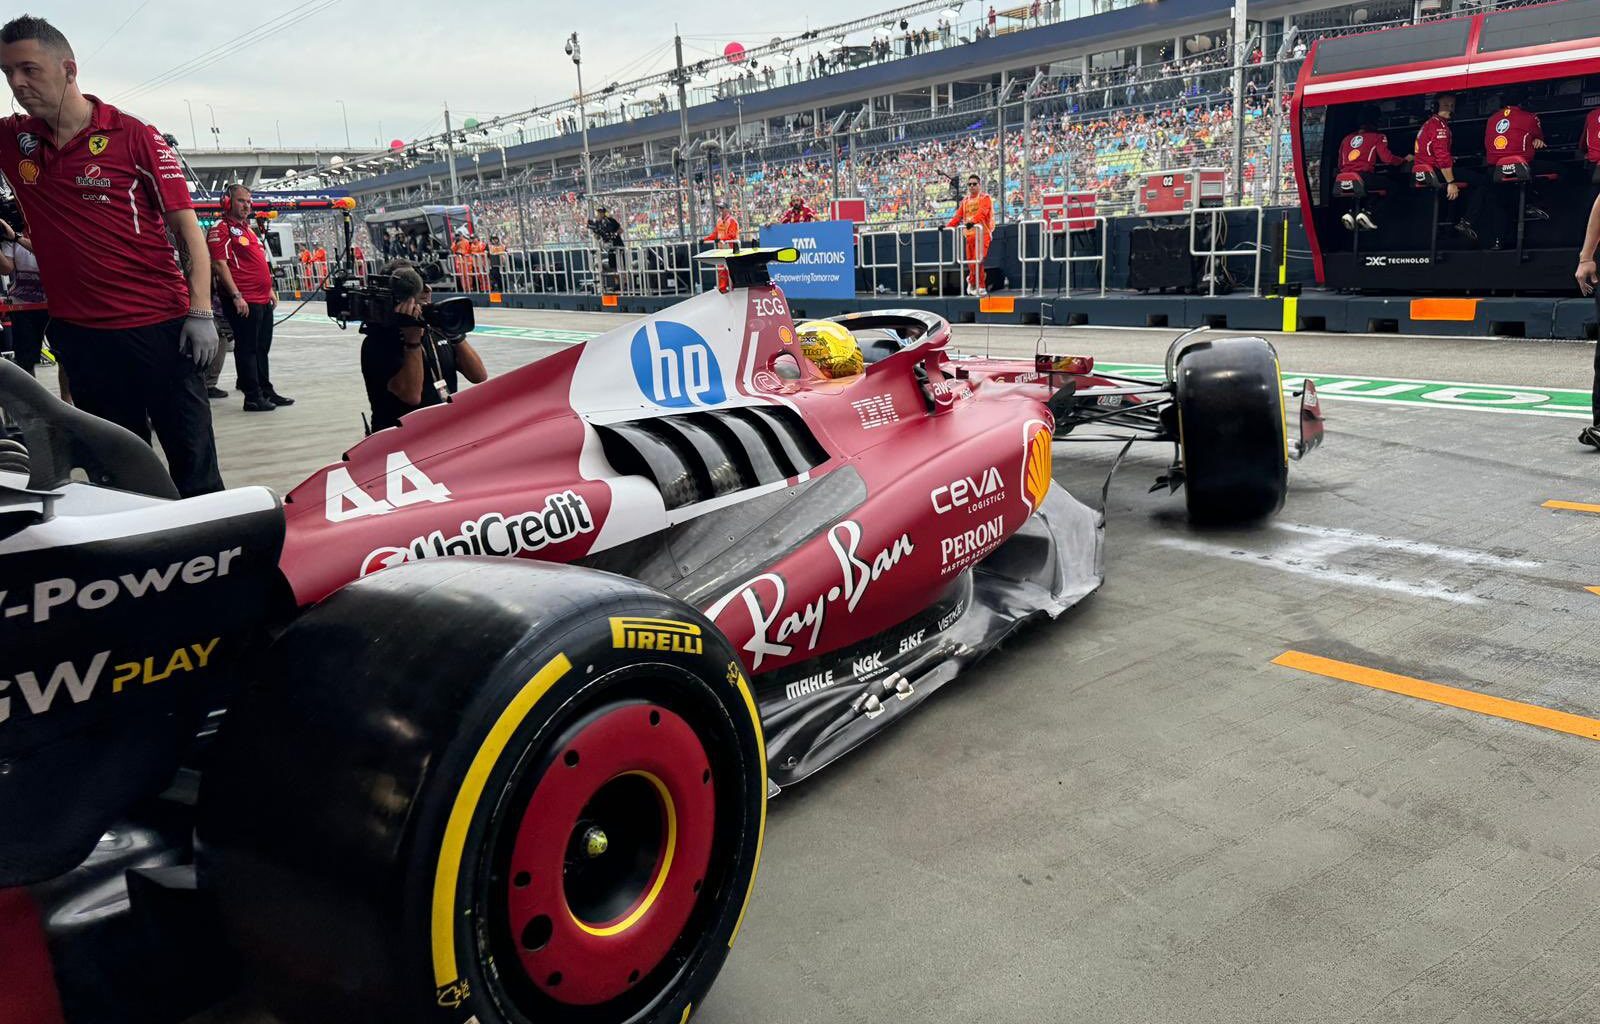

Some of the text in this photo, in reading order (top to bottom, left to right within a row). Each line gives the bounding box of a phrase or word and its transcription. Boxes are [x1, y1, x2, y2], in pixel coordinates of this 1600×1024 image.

[1163, 177, 1173, 186] 02
[791, 237, 817, 249] TATA
[769, 251, 845, 265] NICATIONS
[1365, 256, 1387, 266] DXC
[774, 273, 840, 284] #EmpoweringTomorrow
[645, 320, 713, 407] hp
[851, 393, 900, 430] IBM
[325, 450, 455, 522] 44
[967, 491, 1006, 514] LOGISTICS
[940, 514, 1004, 566] PERONI
[940, 556, 970, 576] NASTRO
[0, 546, 243, 623] -Power
[608, 616, 703, 655] PIRELLI
[898, 628, 926, 654] SKF
[112, 637, 221, 694] PLAY
[852, 650, 884, 679] NGK
[785, 669, 835, 701] MAHLE
